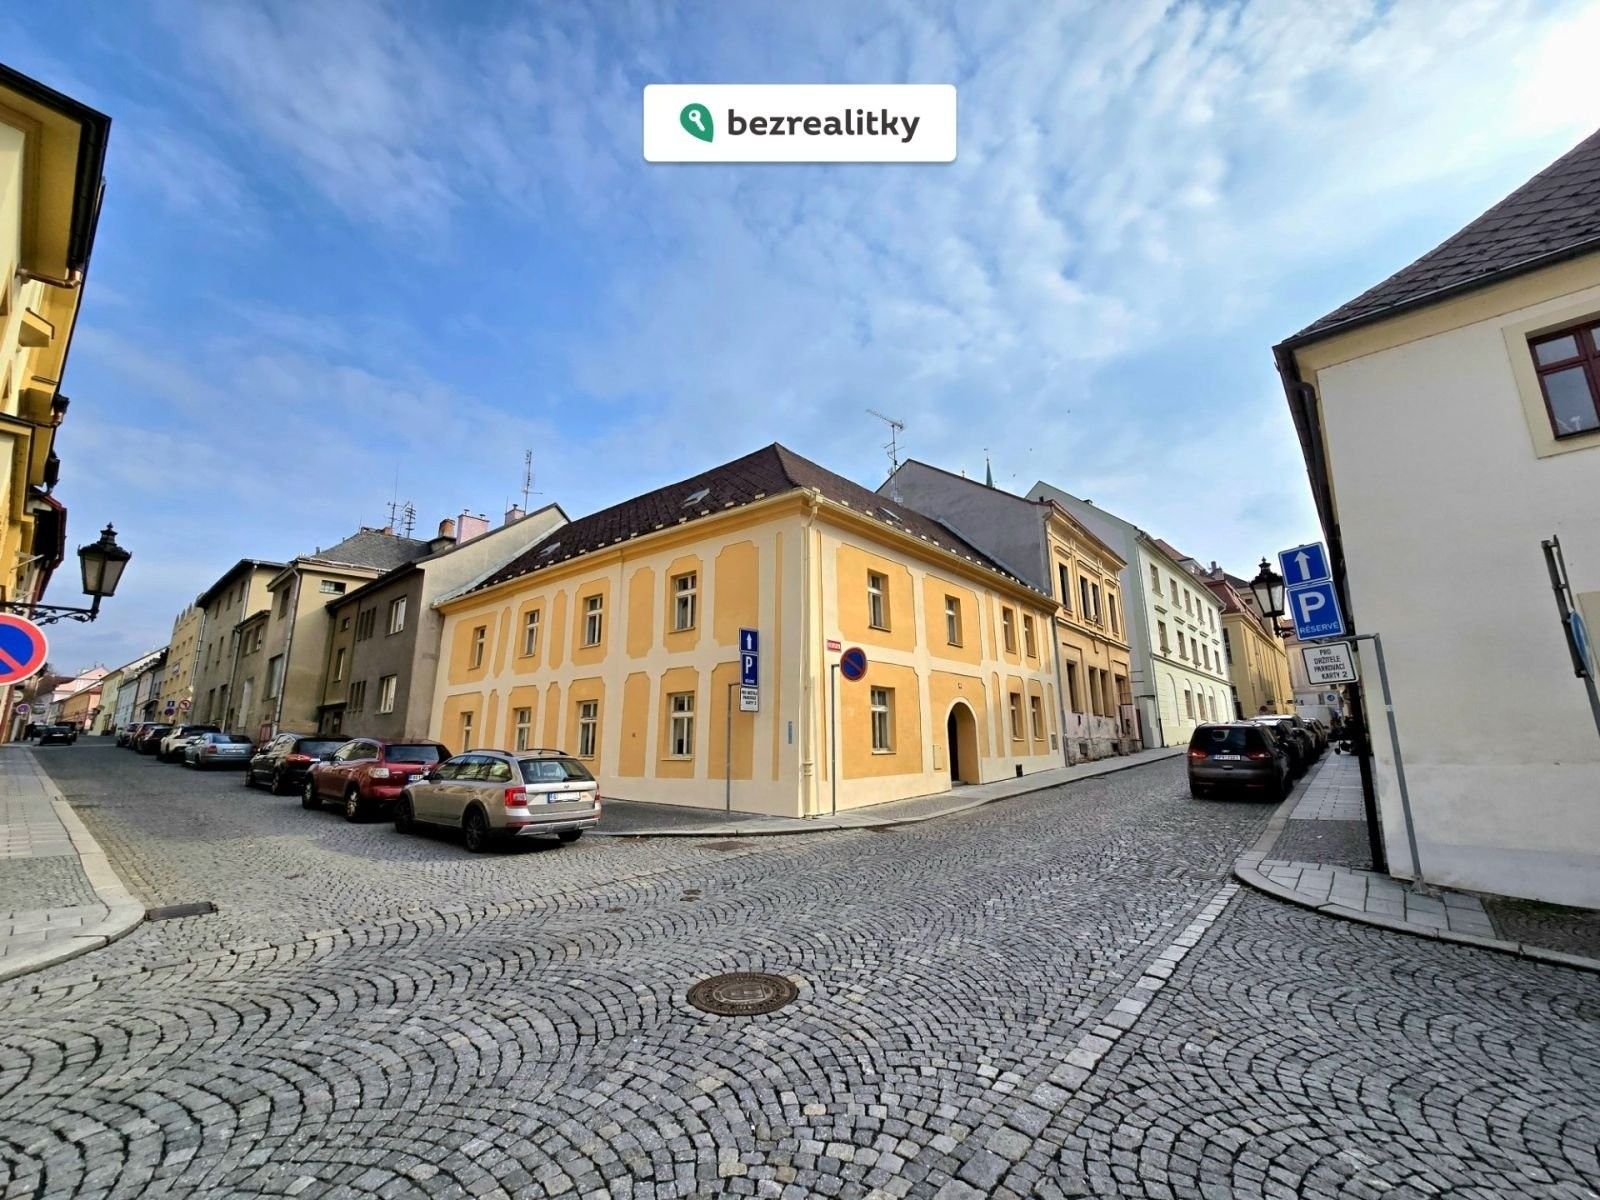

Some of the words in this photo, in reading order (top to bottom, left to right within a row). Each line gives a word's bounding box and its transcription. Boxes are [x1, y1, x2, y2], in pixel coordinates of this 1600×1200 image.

[1298, 591, 1326, 624] P
[1319, 648, 1332, 656] PRO
[745, 656, 753, 674] P
[1321, 671, 1340, 680] KARTY
